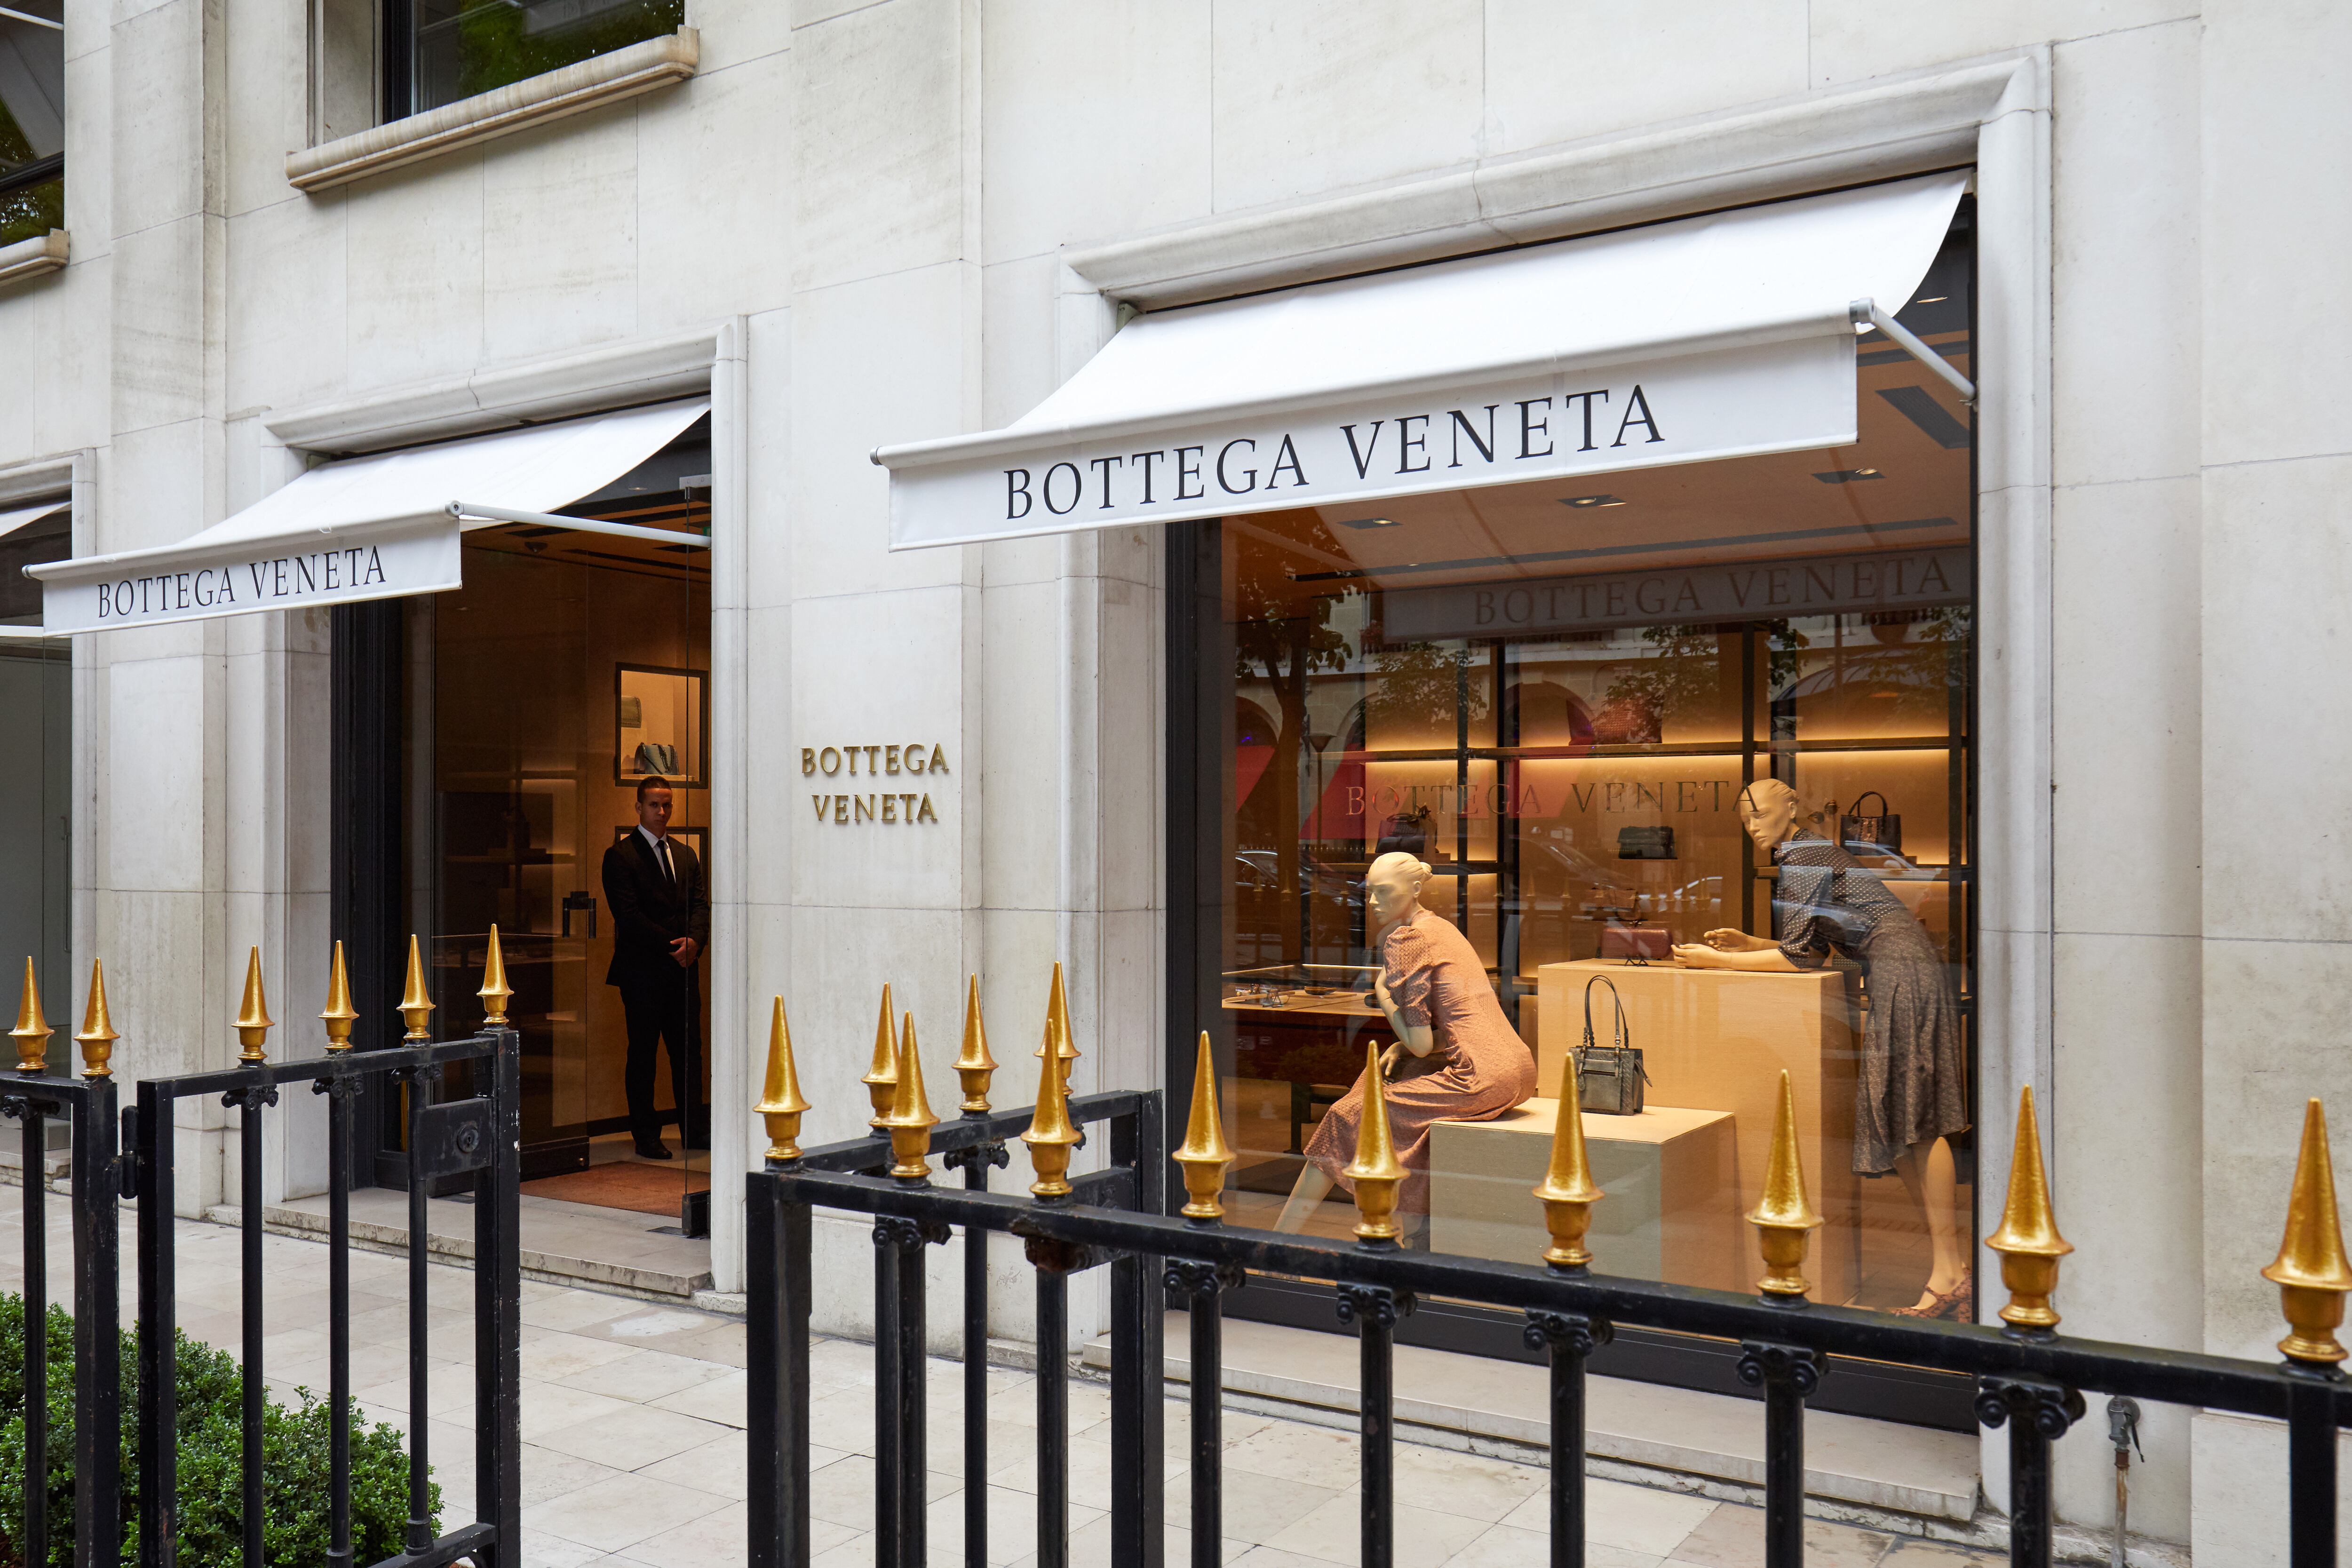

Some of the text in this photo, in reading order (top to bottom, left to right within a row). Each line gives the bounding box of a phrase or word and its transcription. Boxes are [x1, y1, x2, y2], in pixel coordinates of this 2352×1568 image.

[1004, 384, 1666, 520] BOTTEGA VENETA
[98, 545, 386, 618] BOTTEGA VENETA
[1474, 557, 1952, 626] BOTTEGA VENETA
[801, 743, 949, 775] BOTTEGA
[811, 793, 938, 824] VENETA
[1345, 780, 1760, 816] BOTTEGA VENETA
